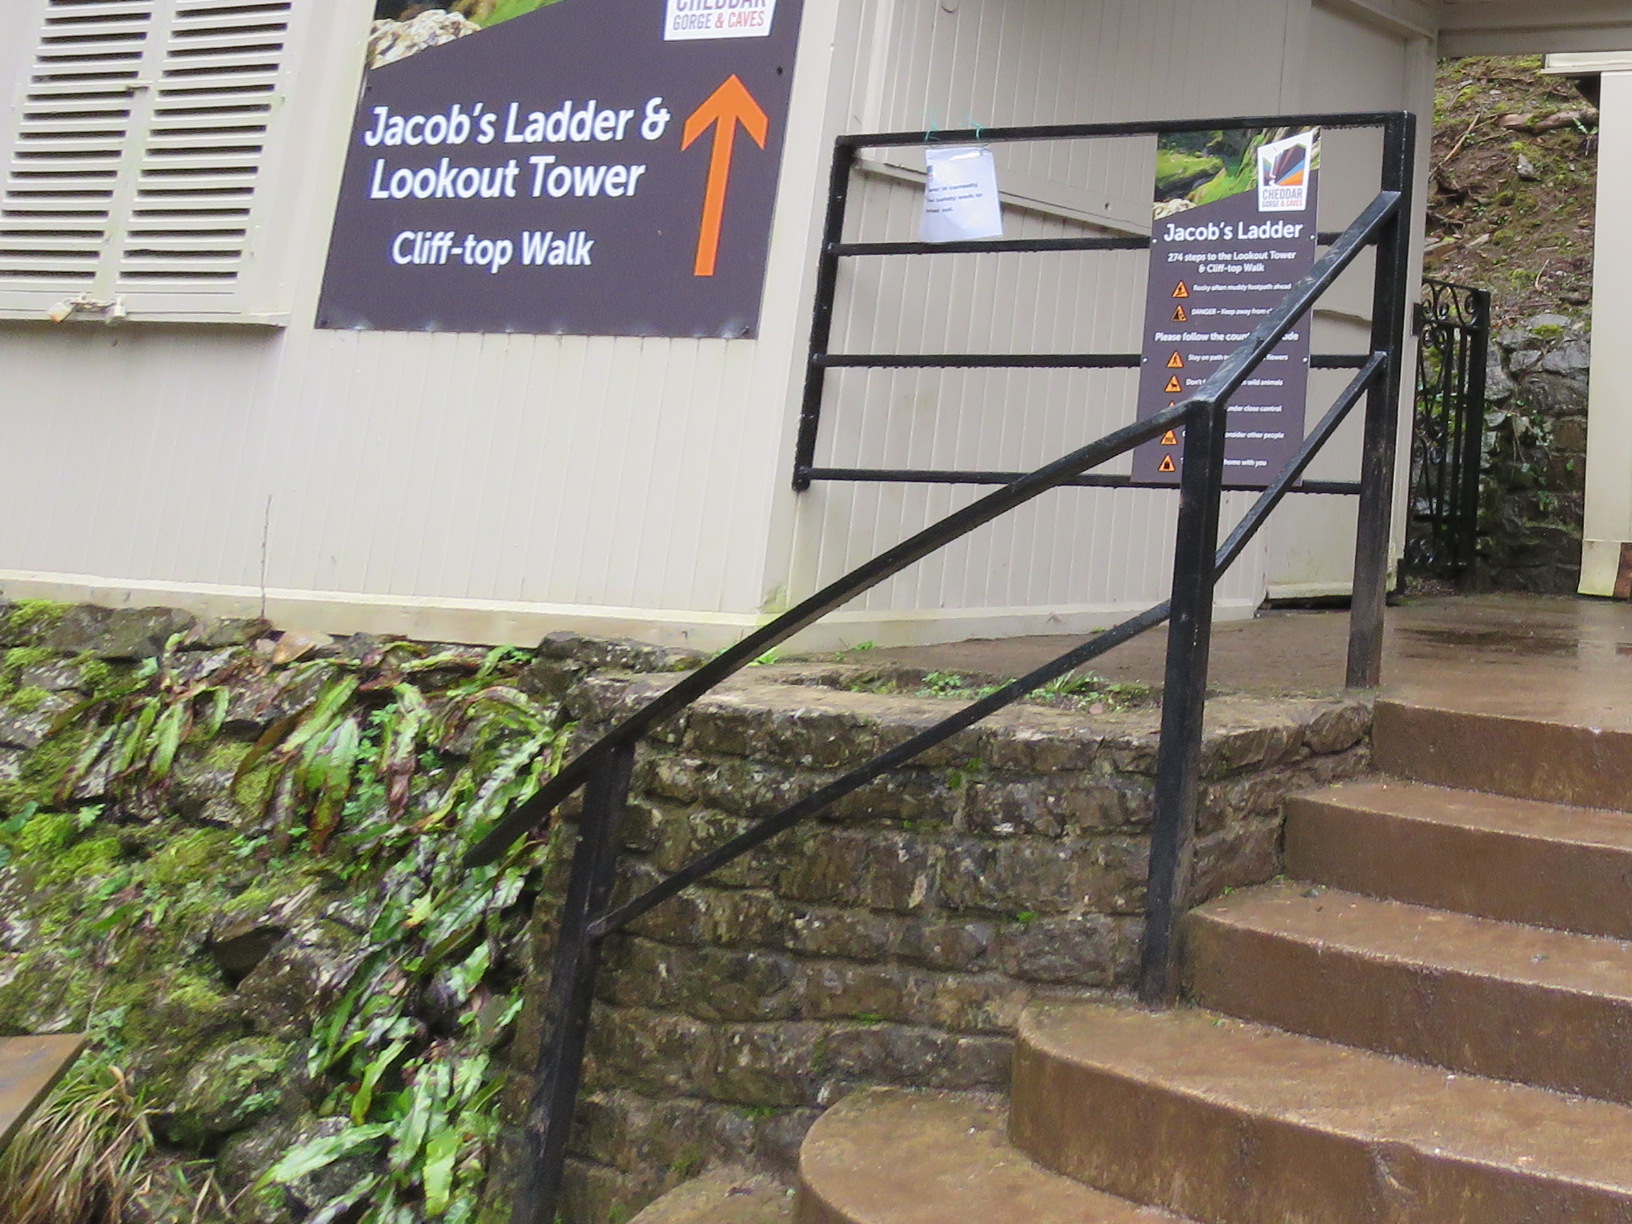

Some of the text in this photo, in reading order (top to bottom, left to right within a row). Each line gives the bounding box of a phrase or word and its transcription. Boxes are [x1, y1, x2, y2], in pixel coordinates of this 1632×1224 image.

[672, 10, 766, 31] GORGE & CAVES
[364, 97, 670, 147] Jacob's Ladder &
[370, 156, 646, 199] Lookout Tower
[1262, 188, 1303, 200] CHEDDAR
[1163, 220, 1304, 242] Jacob's Ladder
[392, 230, 594, 273] Cliff-top Walk
[1167, 250, 1297, 263] 274 steps to the Lookout Tower
[1198, 263, 1265, 274] & Cliff-top Walk
[1155, 332, 1181, 341] Please
[1182, 332, 1209, 341] follow
[1210, 332, 1225, 341] the
